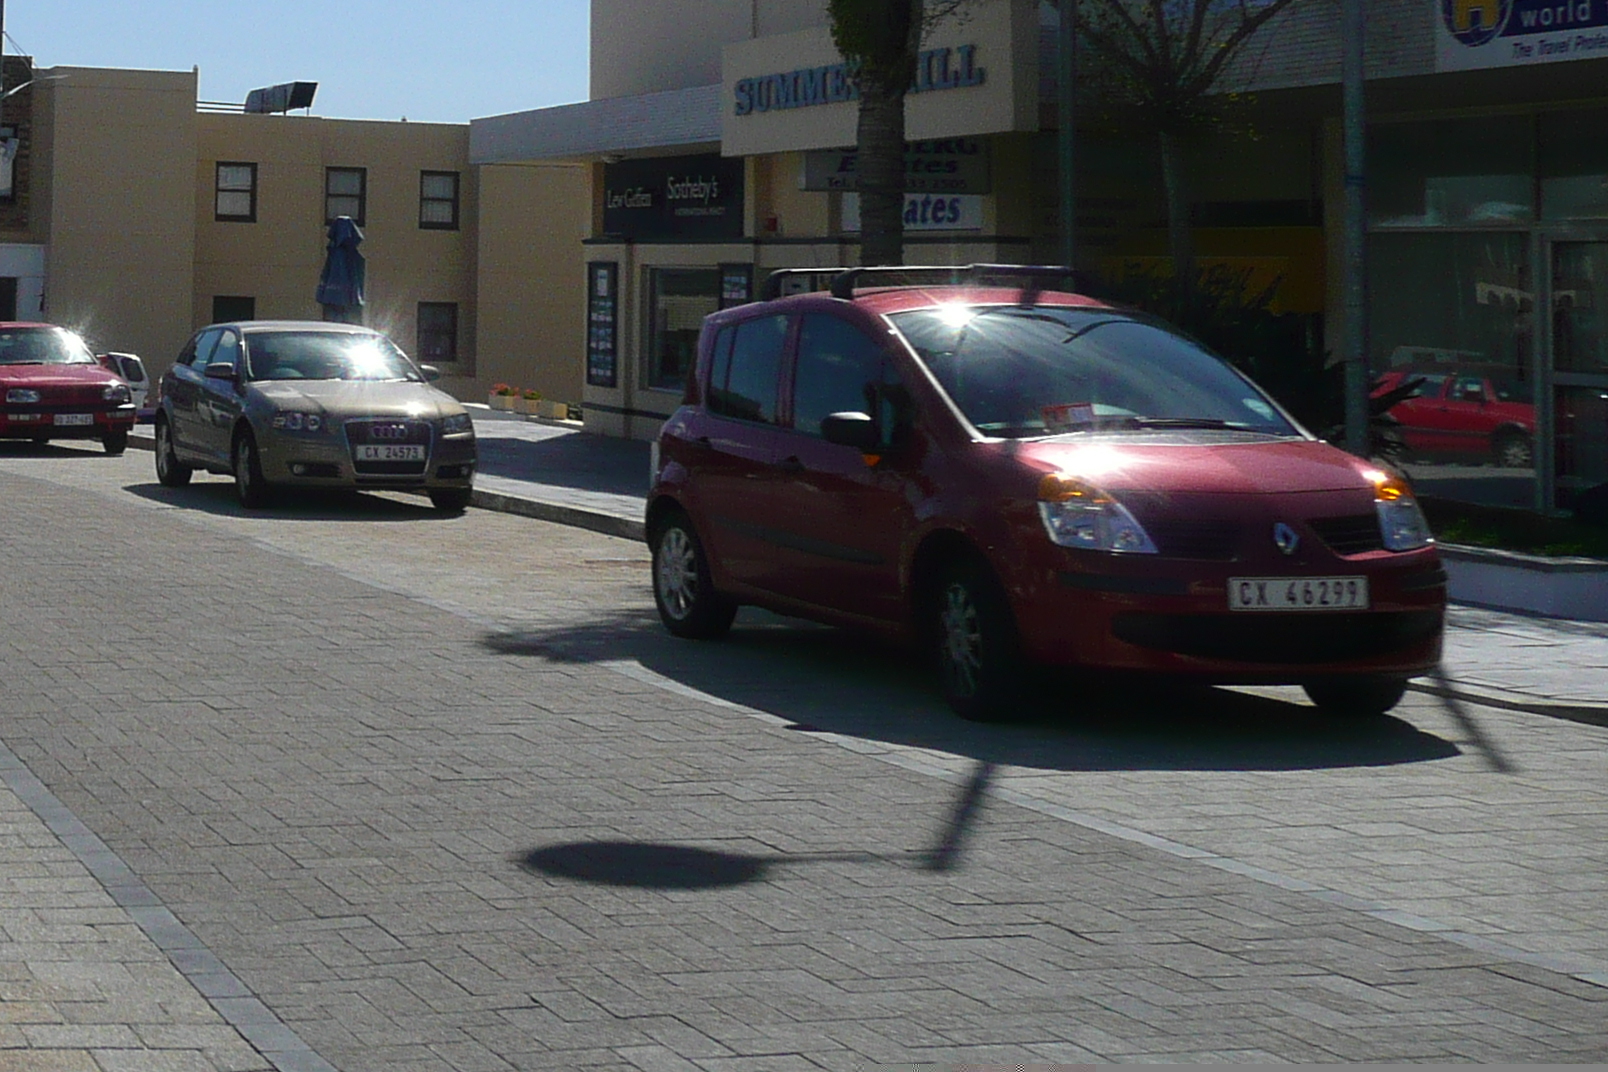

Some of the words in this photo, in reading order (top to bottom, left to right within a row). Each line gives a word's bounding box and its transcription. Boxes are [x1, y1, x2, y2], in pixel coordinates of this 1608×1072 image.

[666, 174, 719, 205] Sotheby's
[904, 192, 960, 226] ates
[365, 446, 379, 459] CX
[385, 446, 419, 459] 24573
[1239, 581, 1268, 606] CX
[1285, 580, 1357, 606] 46299
